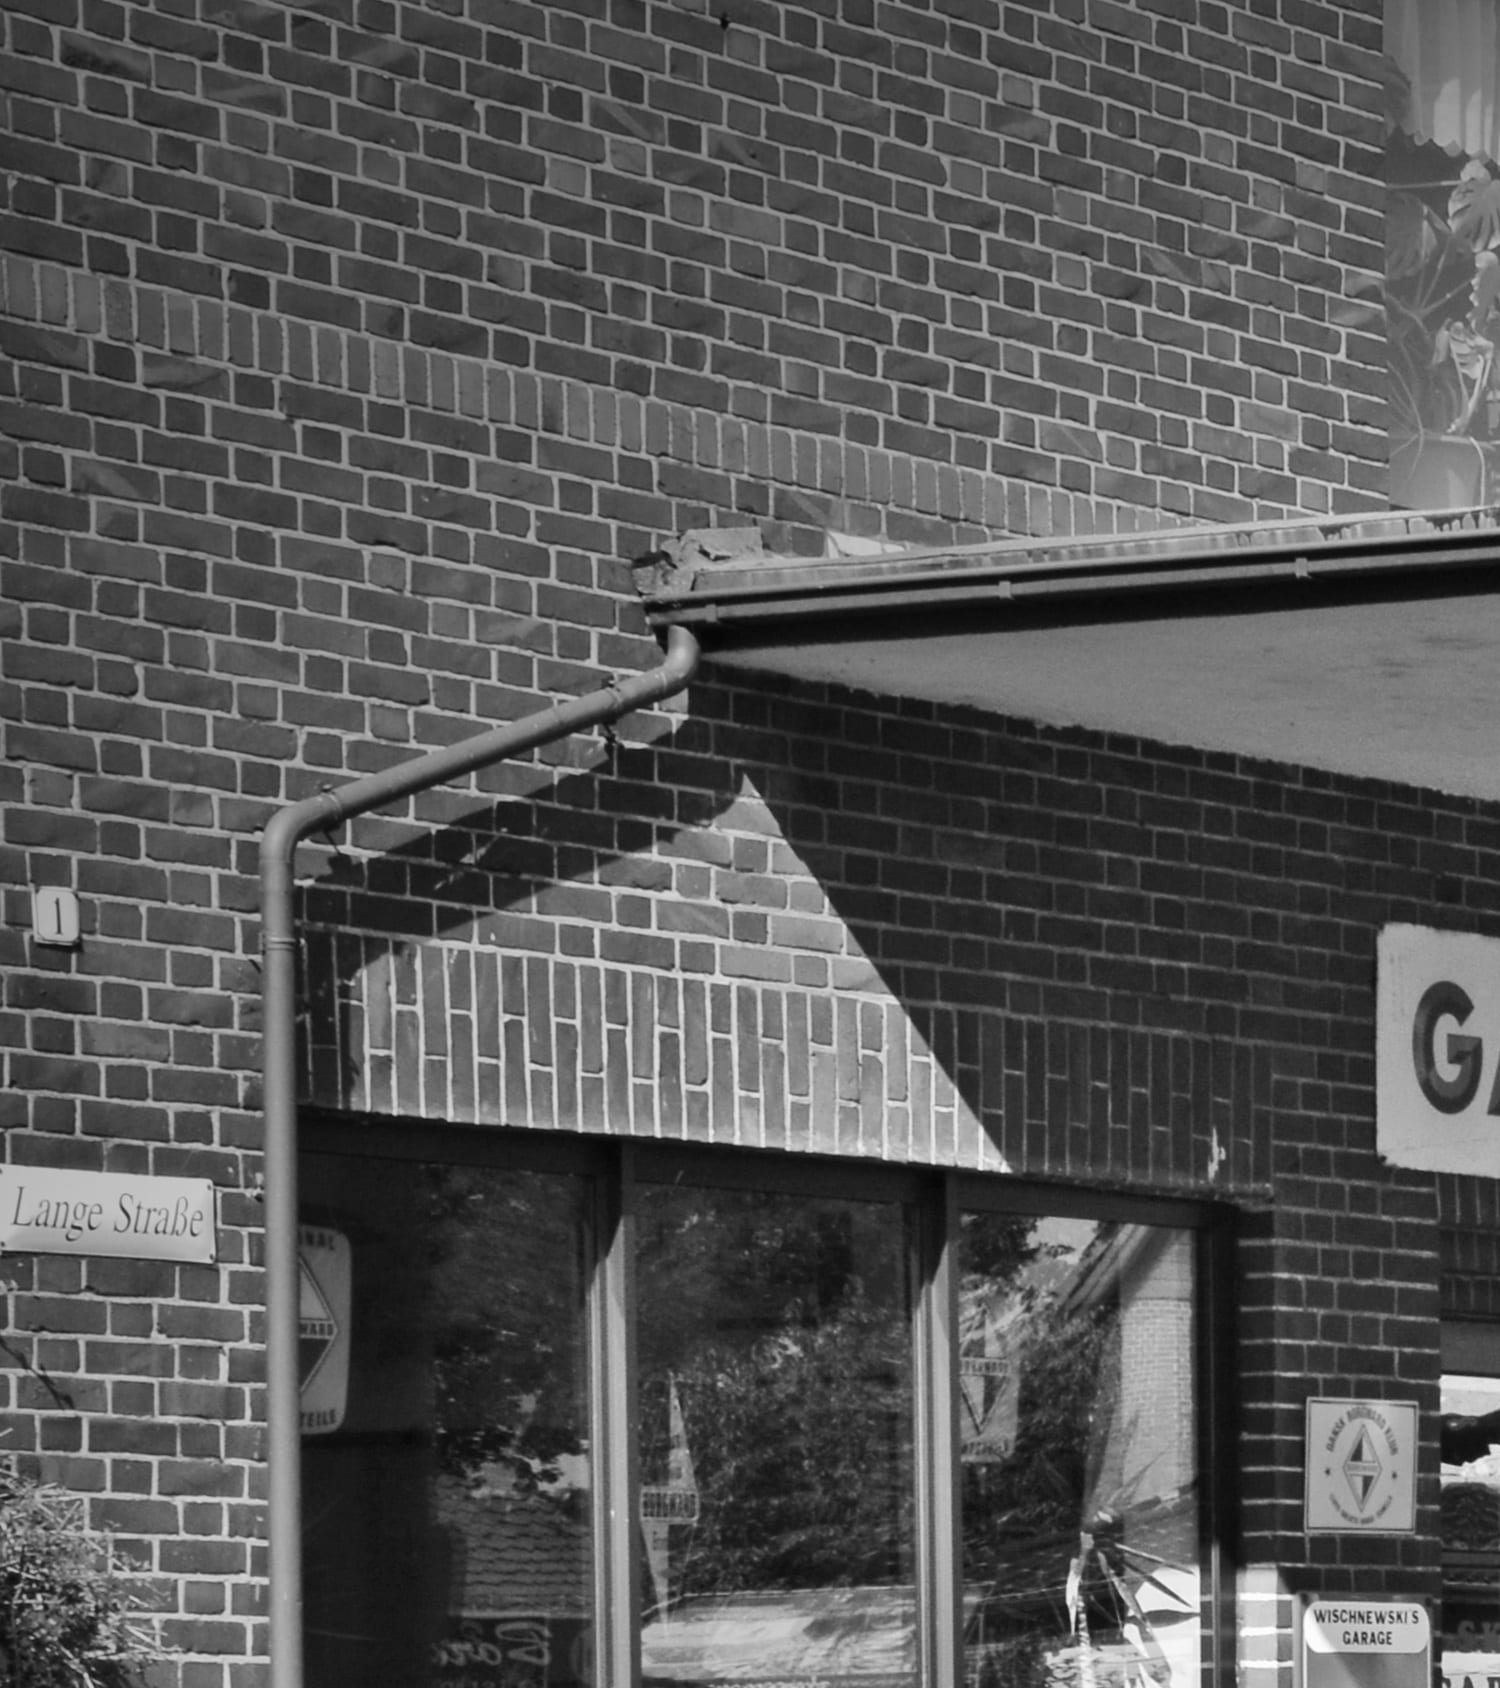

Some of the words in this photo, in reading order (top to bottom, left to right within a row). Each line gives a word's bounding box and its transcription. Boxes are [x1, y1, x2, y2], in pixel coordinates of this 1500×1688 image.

[11, 1185, 103, 1242] Lange
[114, 1193, 204, 1237] Straße
[1342, 1630, 1393, 1646] GARAGE
